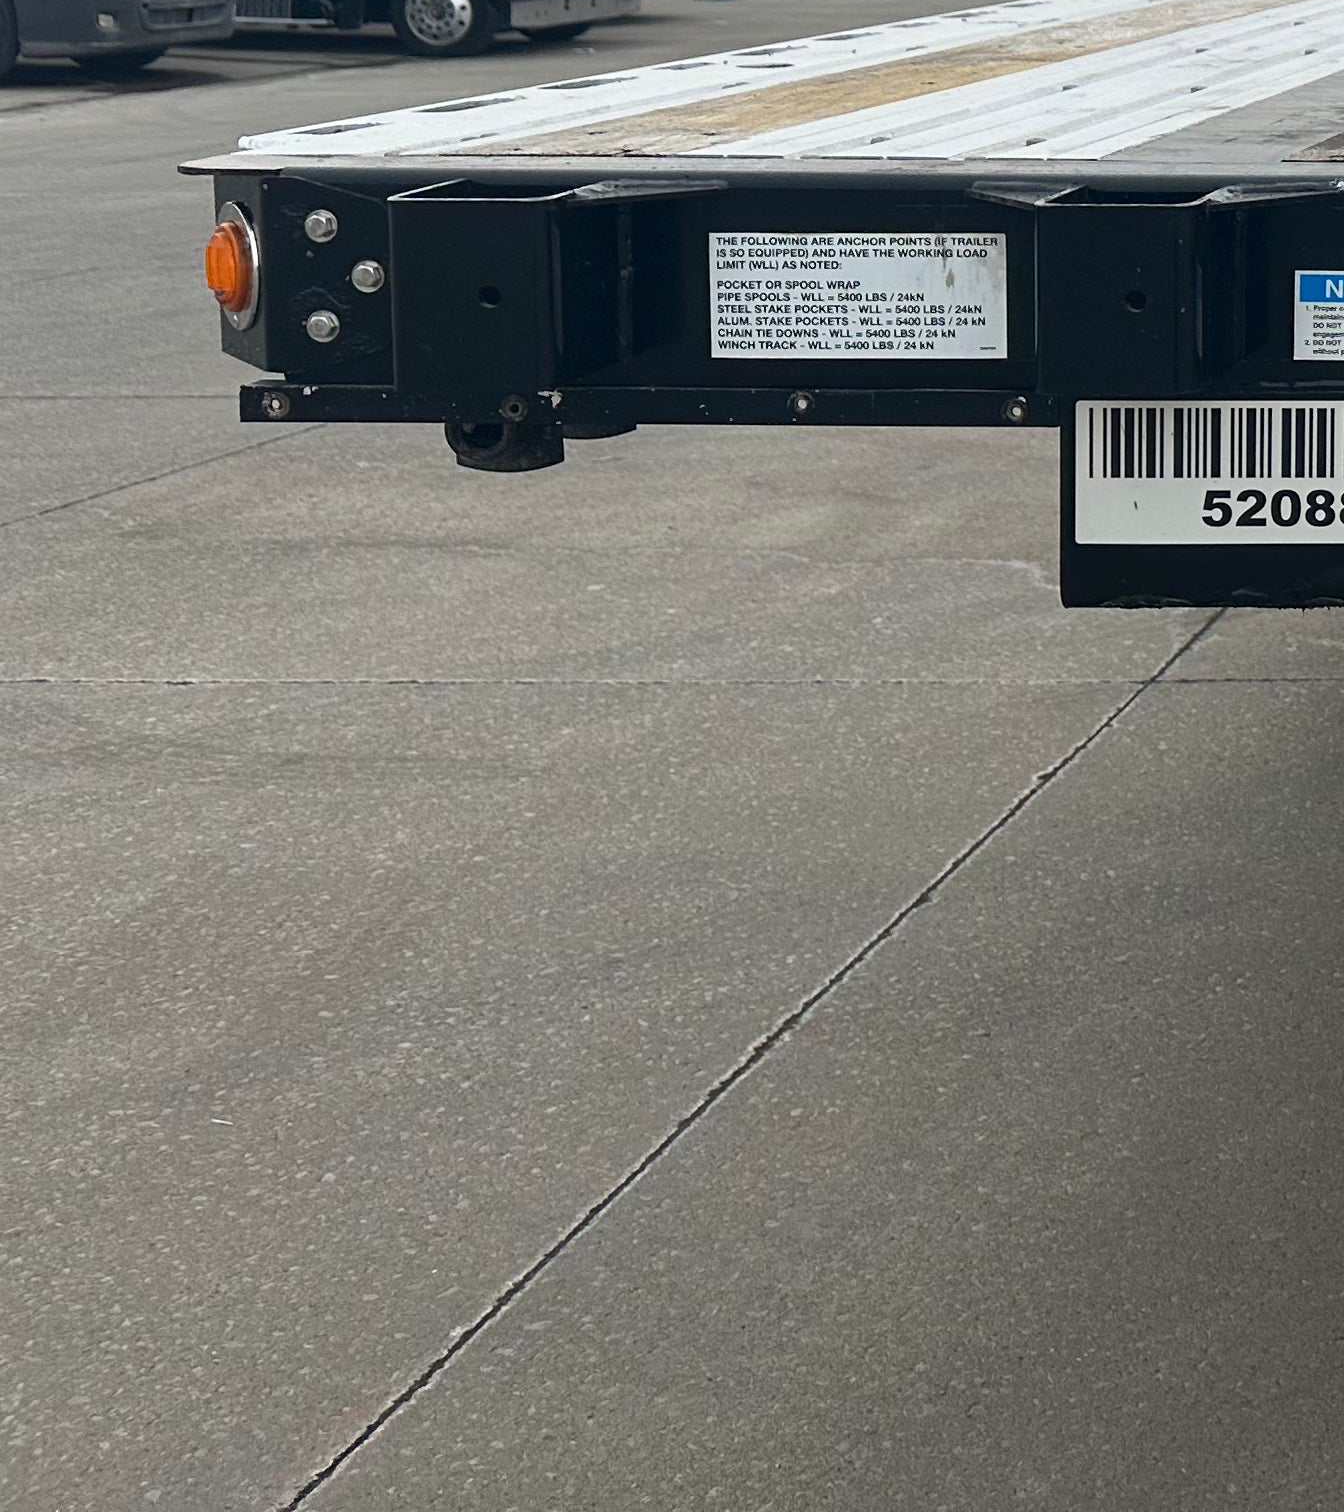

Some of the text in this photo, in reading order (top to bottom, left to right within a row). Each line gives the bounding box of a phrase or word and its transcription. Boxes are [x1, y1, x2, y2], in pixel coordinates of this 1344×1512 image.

[715, 236, 997, 247] THE FOLLOWING ARE ANCHOR POINTS (IF TRAILER
[716, 247, 988, 259] IS SO EQUIPPED) AND HAVE THE WORKING LOAD
[716, 259, 841, 271] LIMIT (WLL) AS NOTED:
[716, 279, 861, 290] POCKET OR SPOOL WRAP
[717, 291, 742, 301] PIPE
[743, 291, 791, 302] SPOOLS
[799, 292, 825, 302] WLL
[836, 292, 863, 302] 5400
[864, 292, 888, 302] LBS
[717, 303, 752, 314] STEEL
[753, 304, 791, 314] STAKE
[793, 304, 848, 314] POCKETS
[857, 304, 882, 314] WLL
[894, 304, 921, 314] 5400
[922, 304, 945, 314] LBS
[717, 316, 752, 326] ALUM.
[754, 316, 792, 326] STAKE
[794, 316, 849, 326] POCKETS
[858, 316, 883, 326] WLL
[895, 316, 921, 326] 5400
[923, 316, 945, 326] LBS
[955, 316, 968, 326] 24
[717, 327, 753, 338] CHAIN
[754, 328, 772, 337] TIE
[775, 328, 819, 338] DOWNS
[828, 328, 853, 338] WLL
[865, 328, 891, 338] 5400
[893, 328, 916, 338] LBS
[924, 328, 938, 338] 24
[717, 339, 755, 350] WINCH
[757, 340, 797, 350] TRACK
[807, 340, 832, 350] WLL
[843, 340, 869, 350] 5400
[872, 340, 894, 350] LBS
[903, 340, 916, 350] 24
